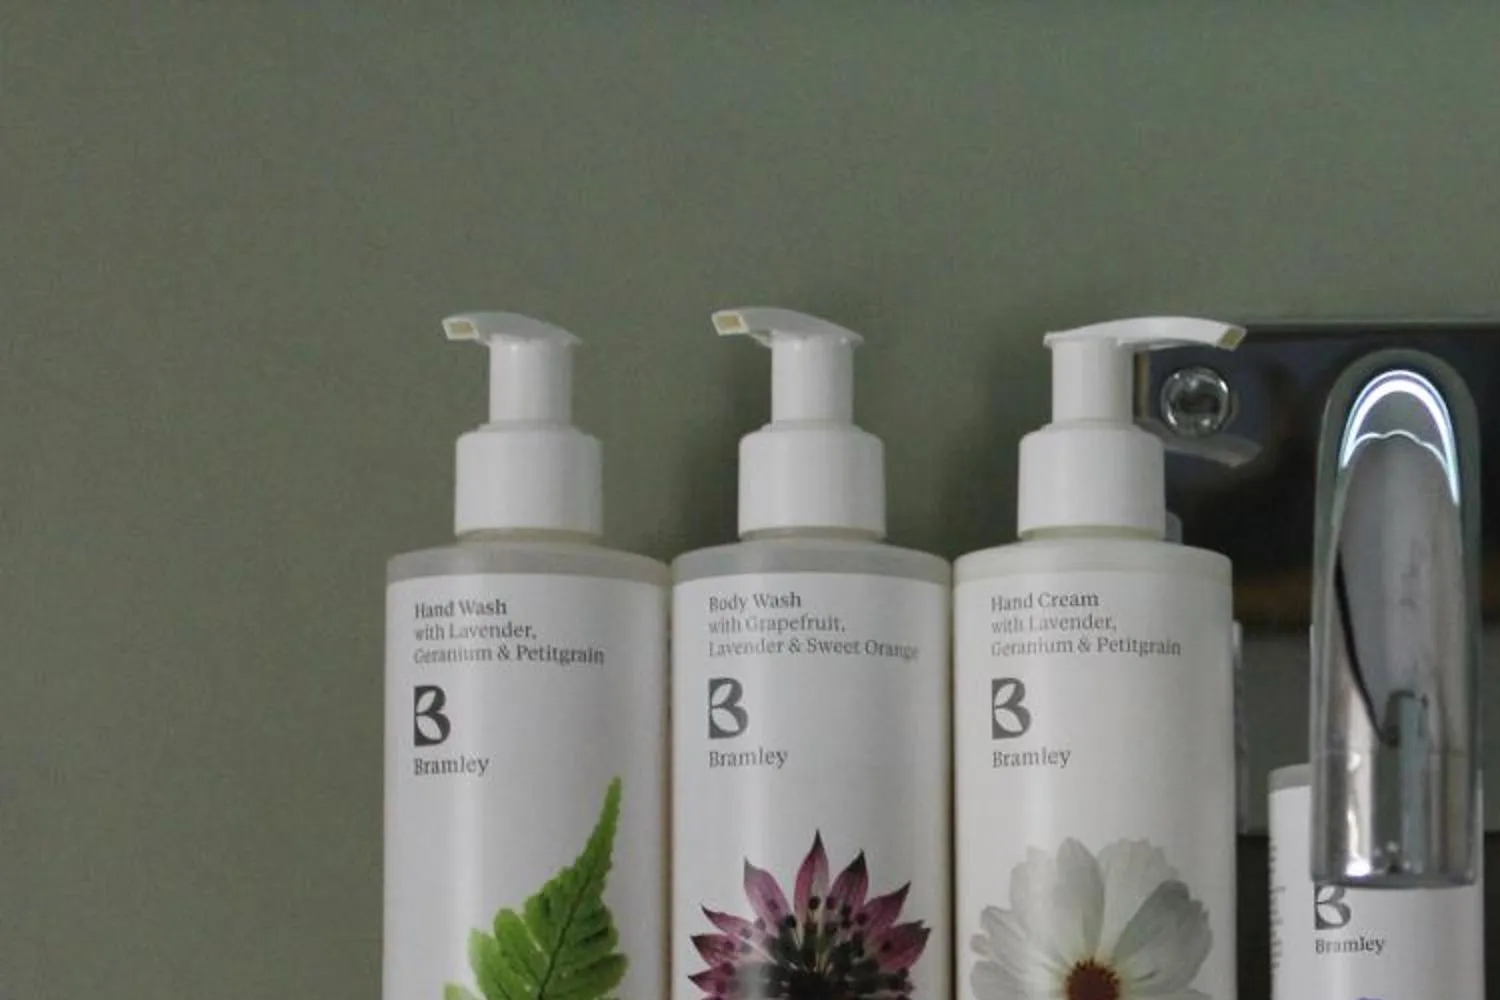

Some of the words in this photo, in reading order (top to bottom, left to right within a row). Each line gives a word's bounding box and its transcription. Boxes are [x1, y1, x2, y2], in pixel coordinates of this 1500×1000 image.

[414, 601, 455, 619] Hand
[457, 599, 508, 617] Wash
[709, 595, 746, 613] Body
[752, 592, 802, 609] Wash
[991, 593, 1033, 612] Hand
[1038, 591, 1100, 608] Cream
[414, 623, 445, 641] with
[450, 622, 537, 641] Lavender,
[709, 615, 741, 634] with
[745, 613, 846, 635] Grapefruit,
[991, 616, 1023, 634] with
[1029, 614, 1117, 633] Lavender,
[414, 645, 493, 664] Geranium
[497, 645, 510, 661] &
[516, 644, 605, 666] Petitgrain
[709, 637, 784, 658] Lavender
[788, 637, 802, 654] &
[807, 637, 860, 655] Sweet
[865, 639, 920, 661] Orange
[991, 638, 1073, 657] Geranium
[1078, 637, 1092, 653] &
[1097, 636, 1182, 657] Petitgrain
[413, 684, 451, 747] B
[708, 677, 749, 739] B
[991, 677, 1032, 740] B
[413, 756, 490, 776] Bramley
[708, 746, 788, 769] Bramley
[991, 747, 1072, 769] Bramley
[1315, 936, 1386, 955] Bramley
